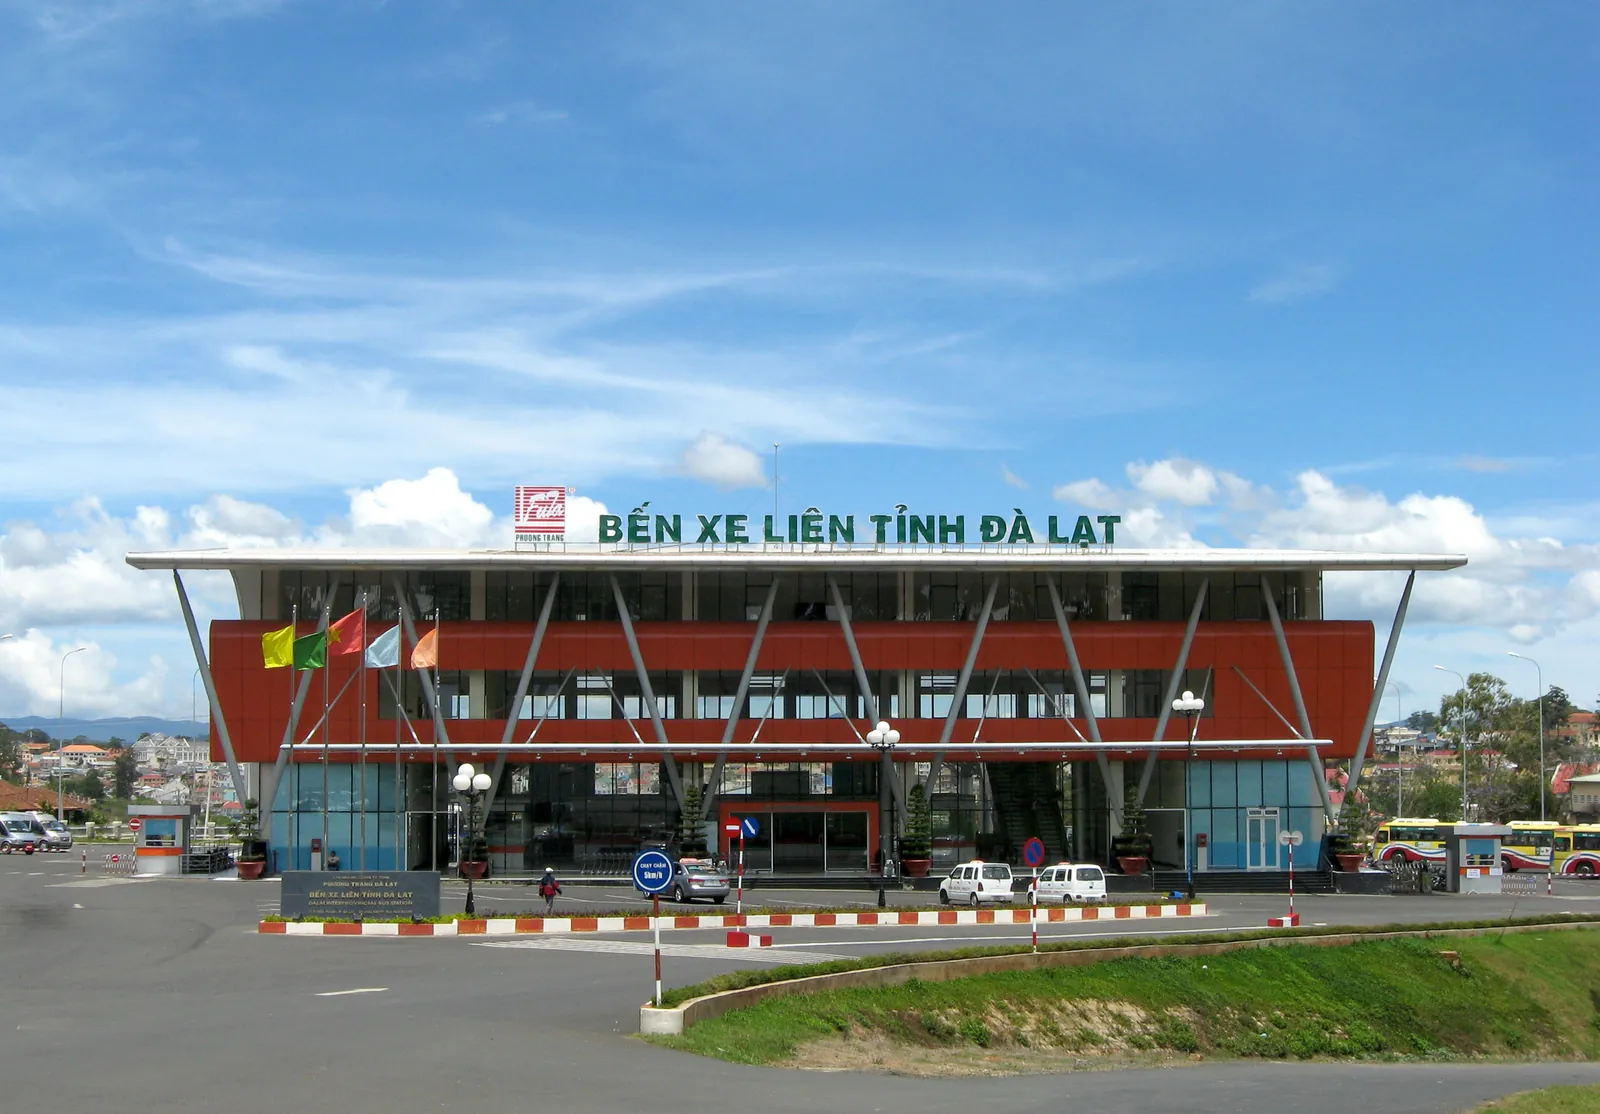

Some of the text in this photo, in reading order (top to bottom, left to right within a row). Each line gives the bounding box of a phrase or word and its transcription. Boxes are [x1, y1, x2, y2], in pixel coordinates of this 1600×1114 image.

[599, 501, 1122, 548] BẾN XE LIÊN TỈNH ĐÀ LẠT
[543, 534, 565, 542] TRANG
[644, 871, 663, 880] 5km/h
